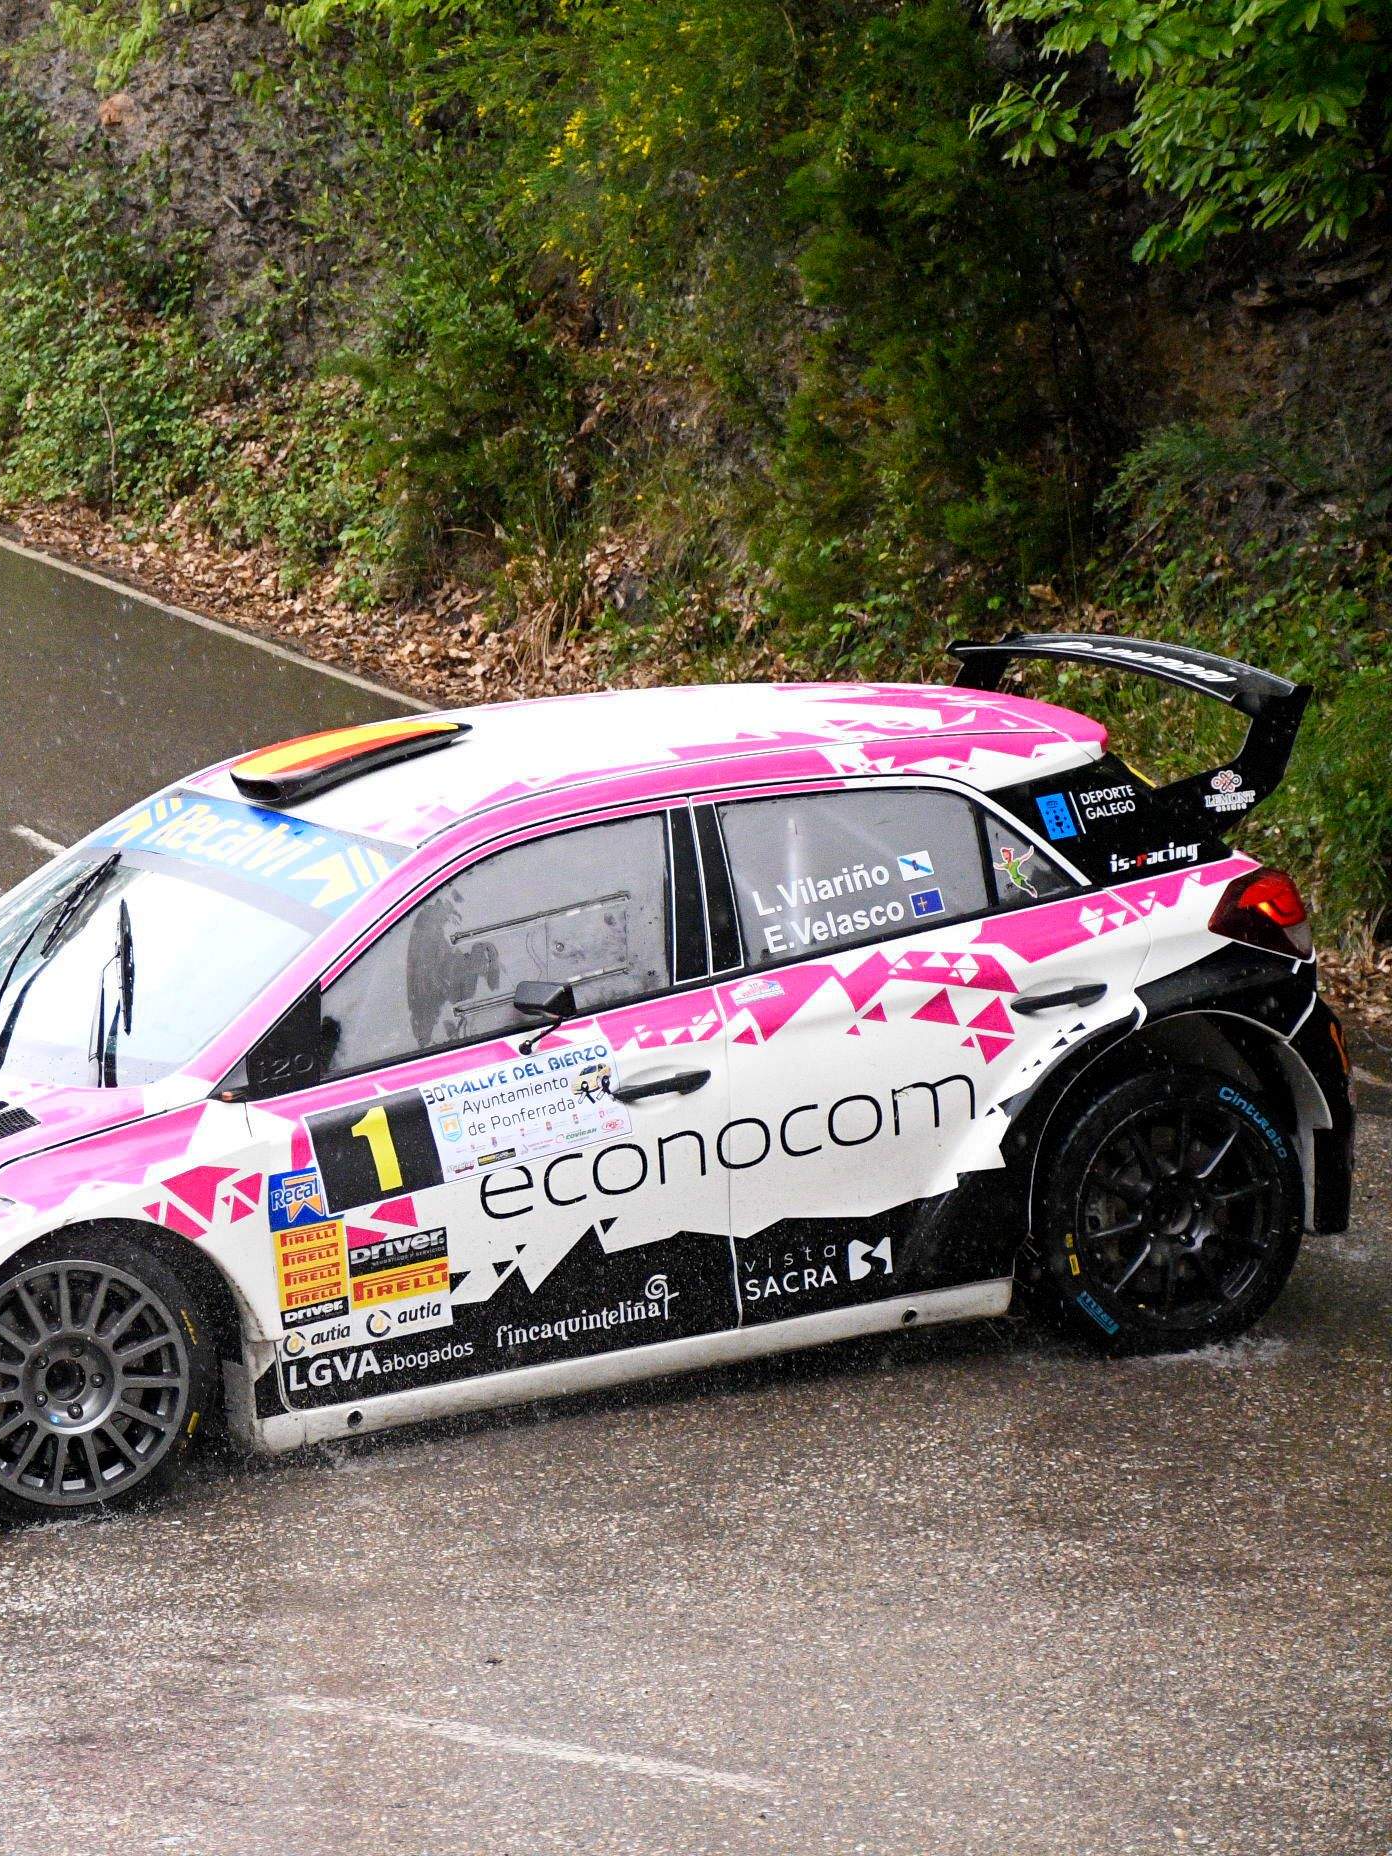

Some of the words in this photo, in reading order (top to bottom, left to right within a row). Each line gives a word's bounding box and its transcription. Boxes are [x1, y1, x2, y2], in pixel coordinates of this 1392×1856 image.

[1079, 785, 1136, 805] DEPORTE
[1085, 799, 1137, 821] GALEGO
[142, 803, 328, 878] Recalvi
[1109, 842, 1202, 873] is-racing
[751, 861, 891, 919] L.Vilariño
[762, 900, 905, 954] E.Velasco
[447, 1069, 508, 1098] RALLYE
[513, 1062, 544, 1081] DEL
[547, 1045, 609, 1071] BIERZO
[462, 1076, 569, 1115] Ayuntamiento
[468, 1121, 491, 1136] de
[491, 1097, 576, 1130] Ponferrada
[1217, 1086, 1288, 1160] Cinturato
[350, 1105, 404, 1192] 1
[479, 1073, 976, 1221] econocom
[271, 1176, 320, 1212] Recal
[280, 1222, 337, 1248] PIRELLI
[282, 1242, 339, 1267] PIRELLI
[744, 1244, 837, 1273] vista
[284, 1262, 341, 1287] PIRELLI
[353, 1262, 449, 1302] PIRELLI
[745, 1265, 838, 1301] SACRA
[286, 1281, 342, 1307] PIRELLI
[397, 1301, 442, 1324] autia
[311, 1324, 351, 1346] autia
[495, 1300, 662, 1348] fincaquinteliña
[289, 1350, 382, 1392] LGVA
[382, 1342, 474, 1373] abogados
